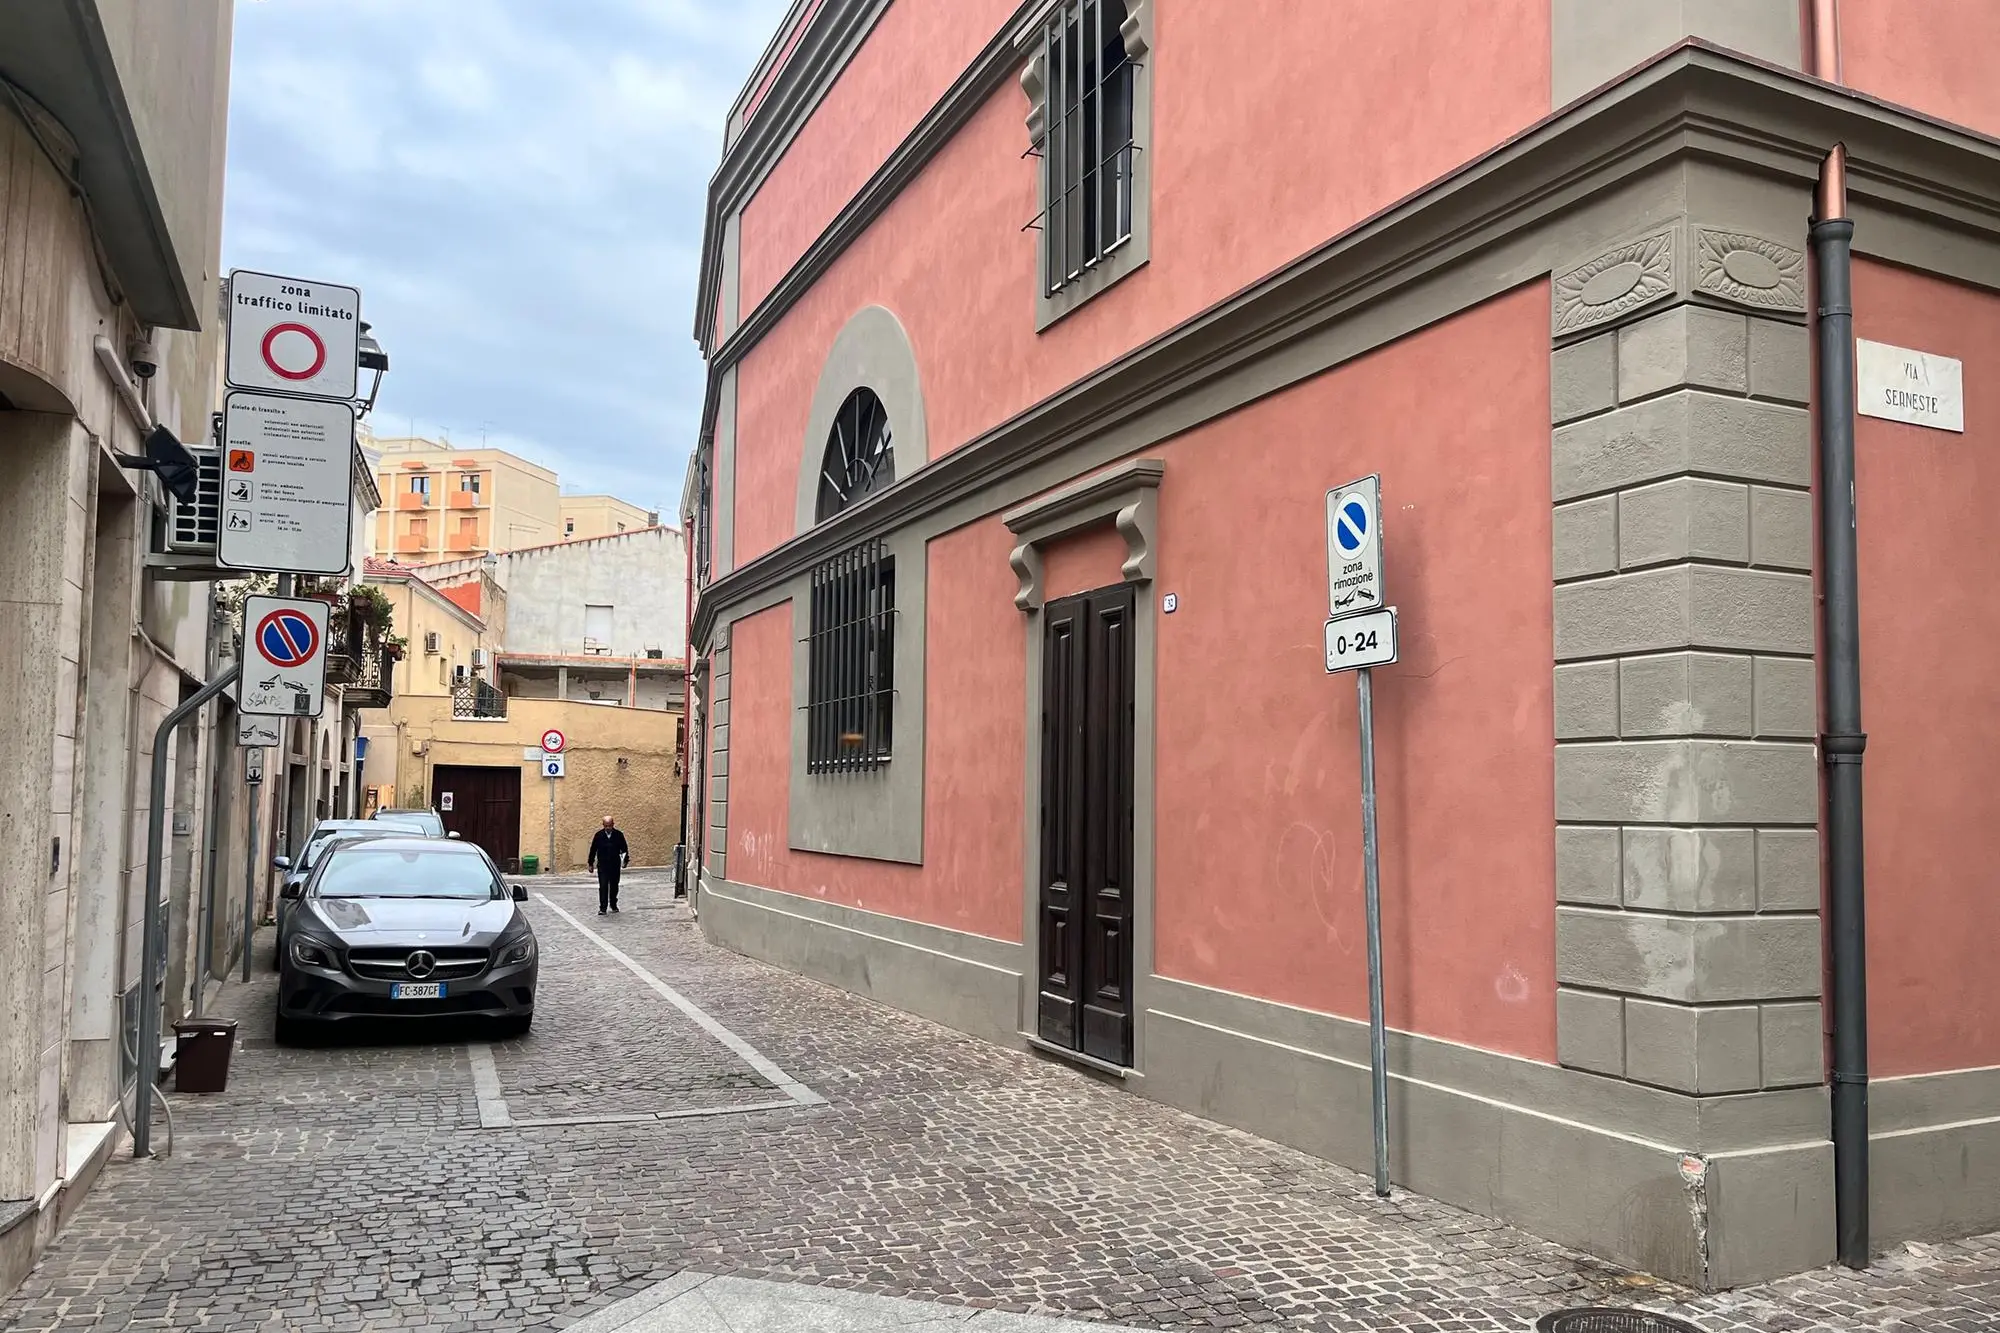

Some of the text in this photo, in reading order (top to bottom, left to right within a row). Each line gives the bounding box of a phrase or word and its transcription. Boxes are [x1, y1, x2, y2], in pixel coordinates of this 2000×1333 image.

[281, 285, 311, 298] zona
[237, 293, 353, 320] traffico limitato
[1903, 362, 1918, 380] VIA
[1885, 388, 1938, 414] SERNESTE
[1343, 561, 1363, 575] zona
[1334, 571, 1374, 590] rimozione
[1337, 630, 1378, 655] 0-24
